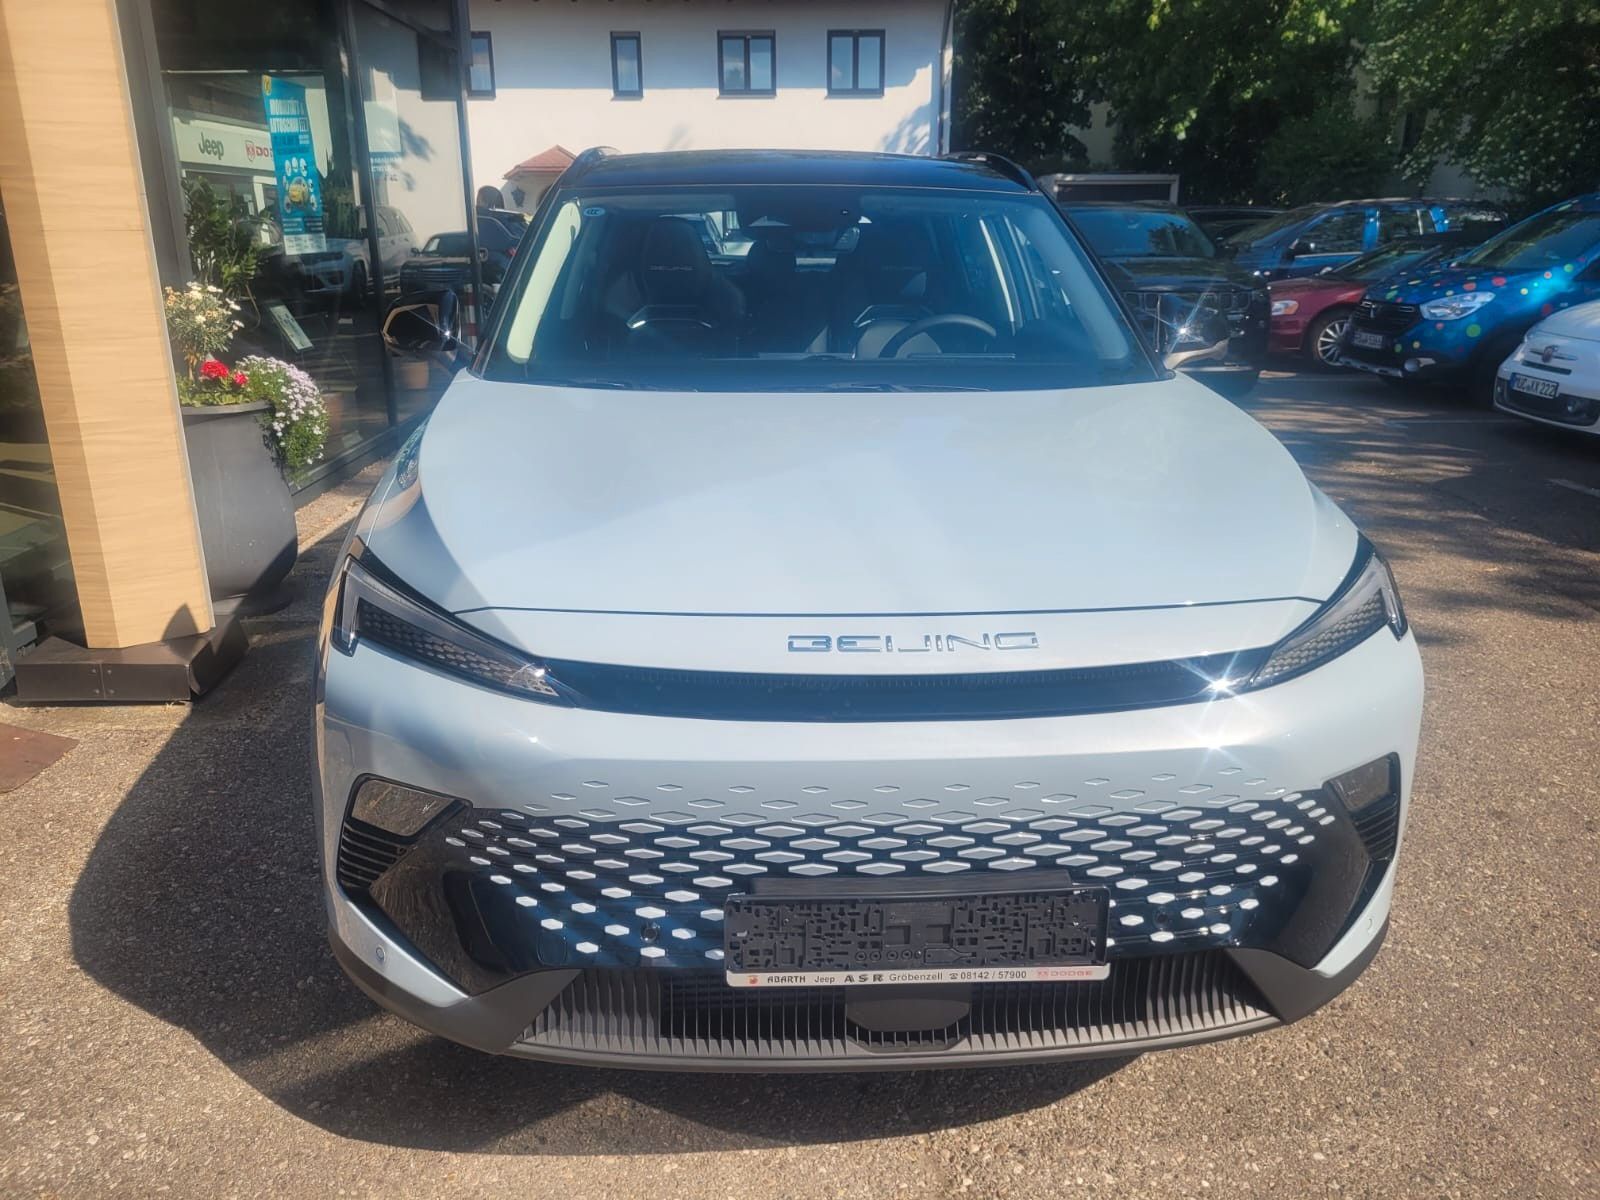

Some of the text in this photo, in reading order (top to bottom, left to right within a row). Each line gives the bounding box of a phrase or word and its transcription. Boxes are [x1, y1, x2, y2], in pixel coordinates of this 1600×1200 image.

[198, 132, 225, 160] Jeep
[787, 631, 1040, 653] BEIJING
[767, 974, 806, 984] ABARTH
[814, 974, 836, 984] Jeep
[889, 971, 943, 982] Gröbenzell
[960, 971, 990, 980] 08142
[998, 970, 1027, 979] 57900
